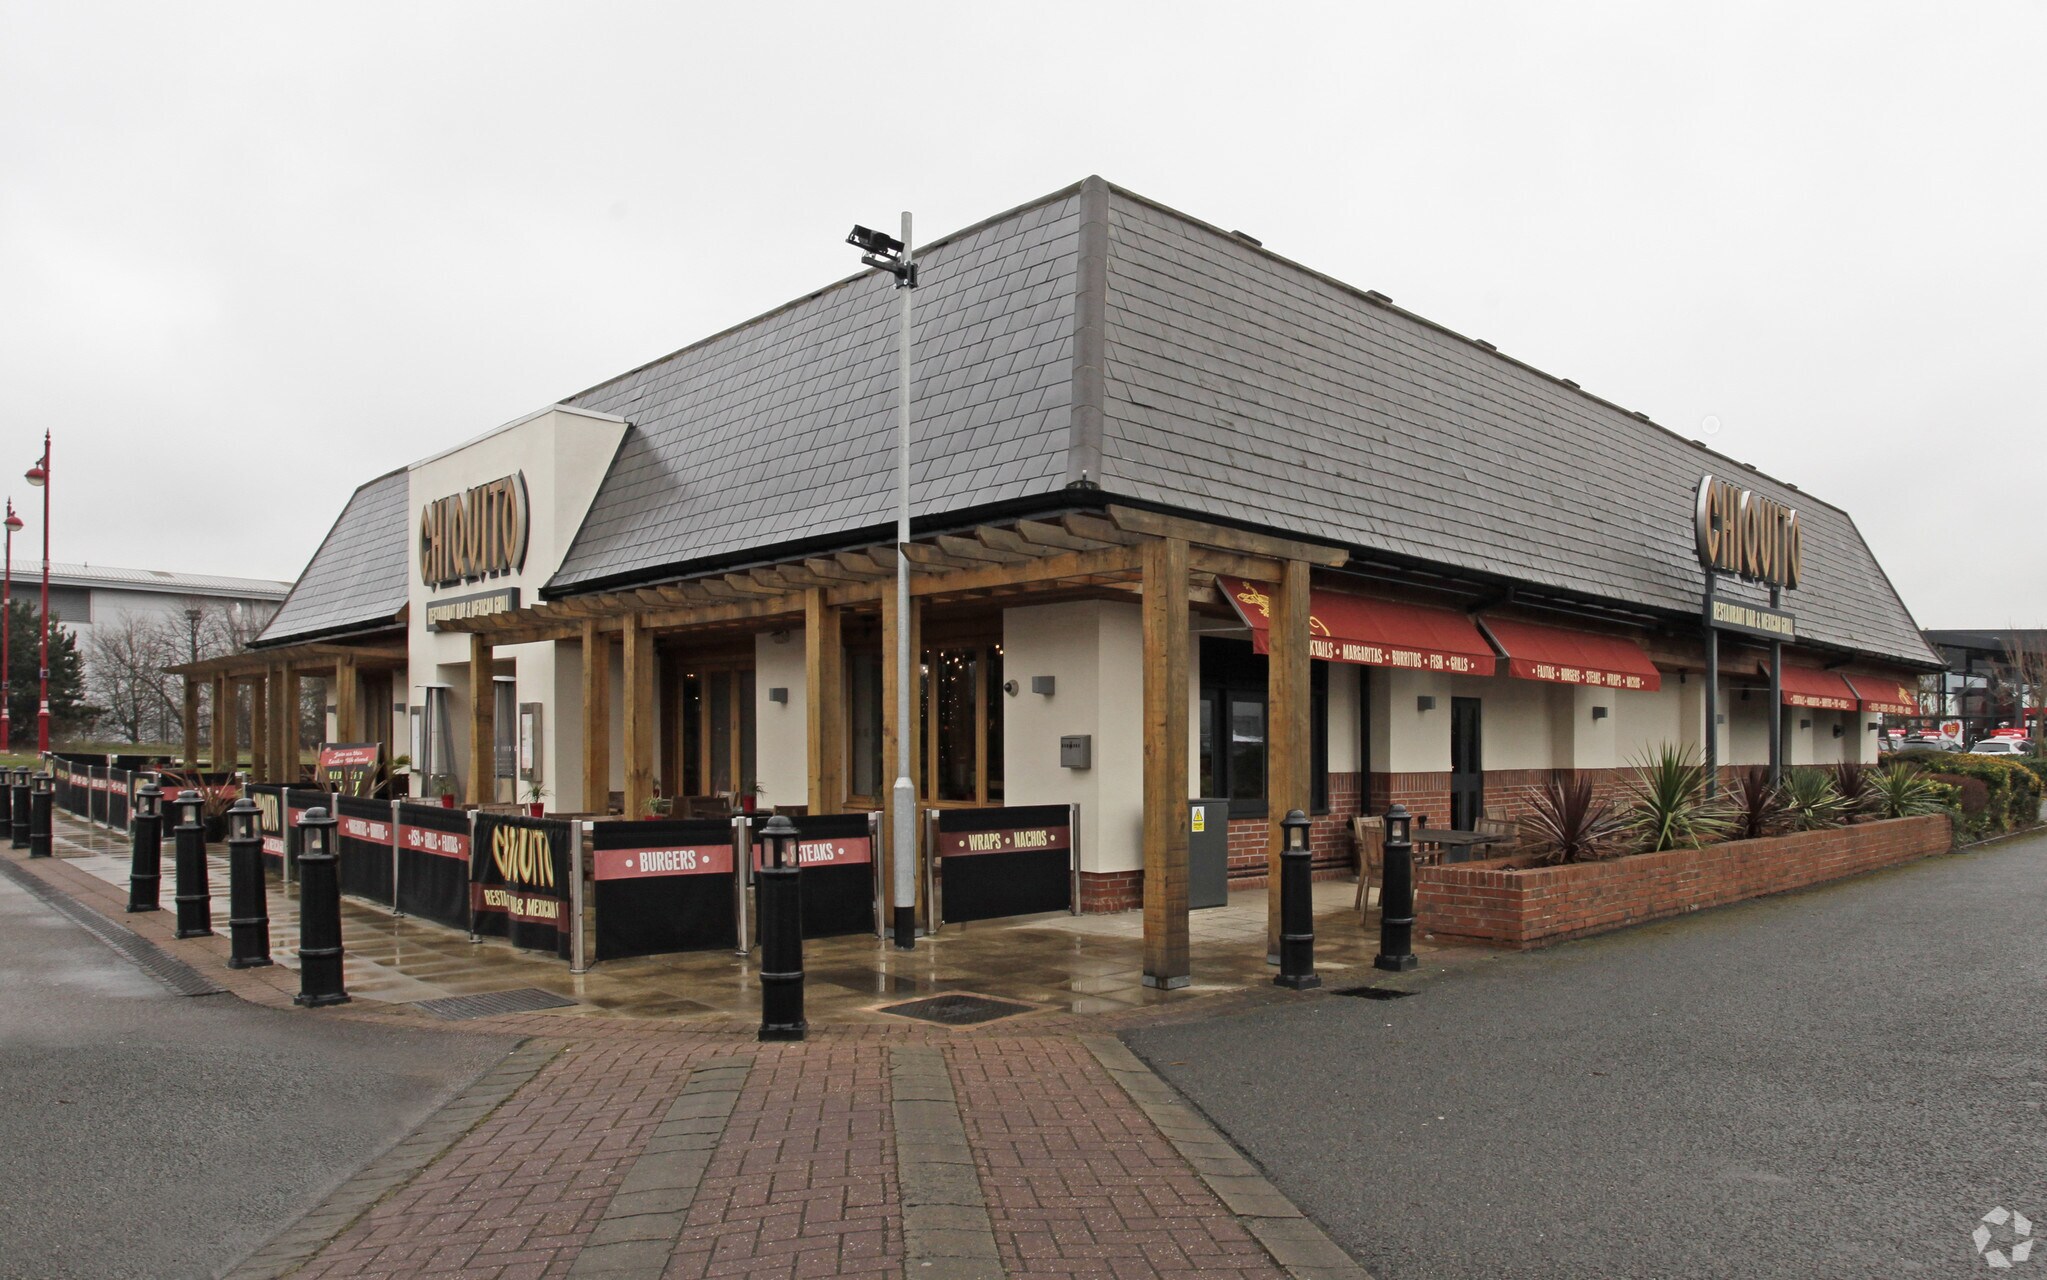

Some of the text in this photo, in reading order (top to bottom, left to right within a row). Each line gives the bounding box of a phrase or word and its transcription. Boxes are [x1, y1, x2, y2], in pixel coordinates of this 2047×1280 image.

[419, 474, 522, 586] CHIQUITO
[1700, 475, 1802, 588] CHIQUITO
[1713, 601, 1745, 625] RESTAURANT
[1310, 640, 1468, 671] KTAILS MARGARITAS BURRITOS FISH GRILLS
[968, 830, 1047, 851] WRAPS NACHOS
[639, 850, 696, 872] BURGERS
[791, 843, 834, 863] STEAKS
[526, 899, 556, 918] MEXICAN
